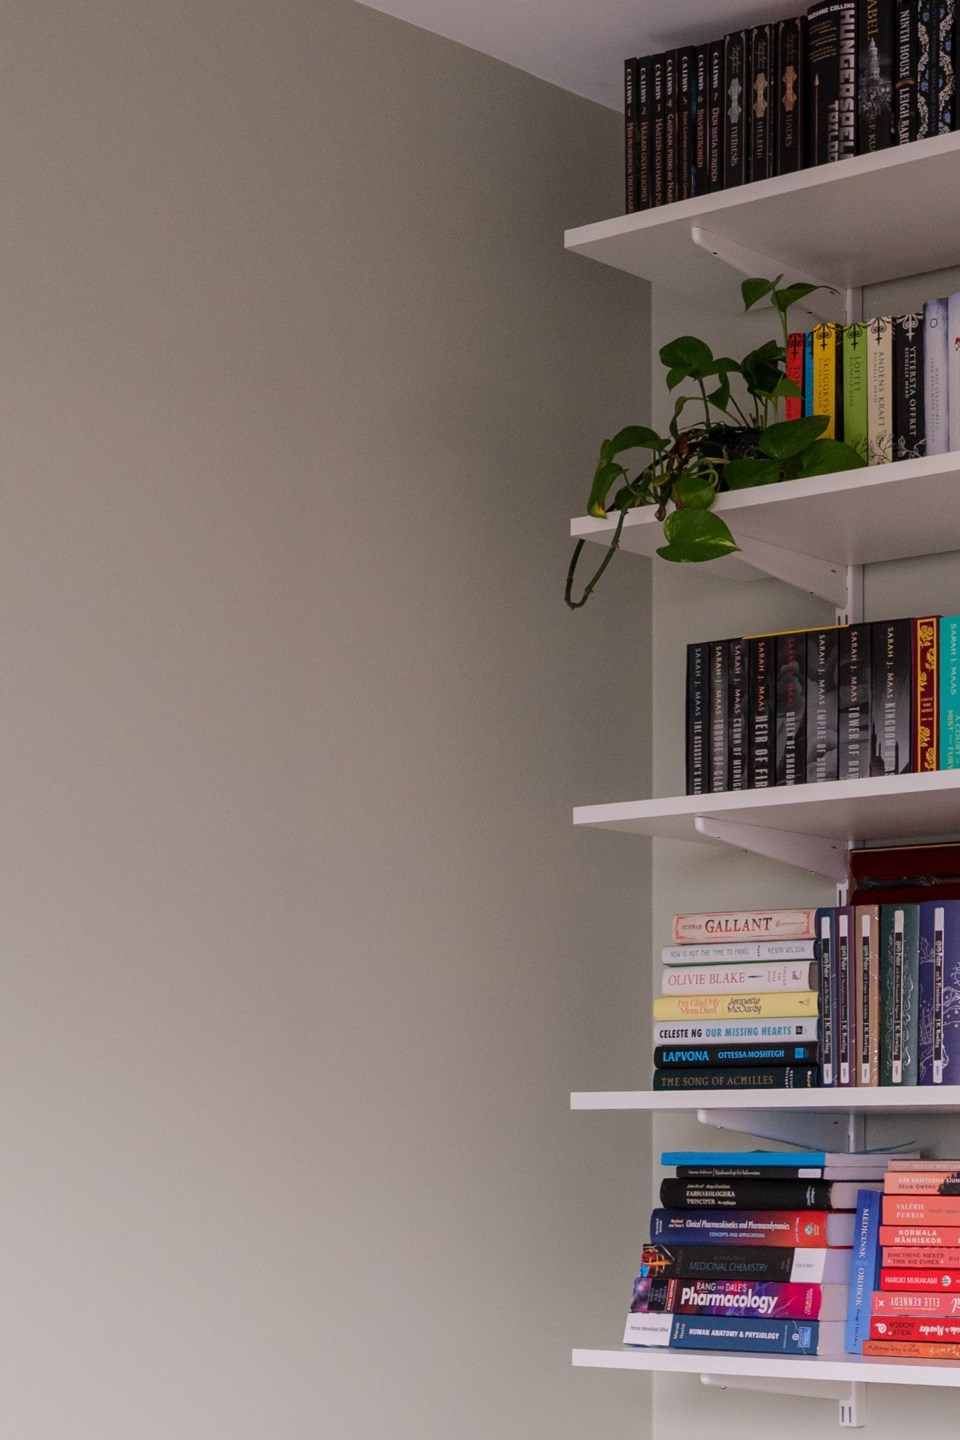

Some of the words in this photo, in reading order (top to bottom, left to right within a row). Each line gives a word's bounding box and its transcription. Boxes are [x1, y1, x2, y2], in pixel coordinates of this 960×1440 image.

[900, 9, 910, 40] NINTH
[900, 40, 910, 78] HOUSE
[900, 88, 910, 118] LEIGH
[909, 345, 918, 397] YTTERSTA
[878, 399, 886, 427] KRAFT
[909, 401, 918, 436] OFFRET
[755, 715, 768, 743] HEIR
[755, 749, 768, 762] OF
[705, 917, 772, 934] GALLANT
[668, 973, 706, 986] OLIVIE
[709, 972, 746, 984] BLAKE
[659, 1029, 688, 1039] CELESTE
[692, 1028, 702, 1038] NG
[705, 1028, 722, 1037] OUR
[724, 1026, 759, 1037] MISSING
[761, 1025, 792, 1036] HEARTS
[663, 1051, 709, 1062] LAPVONA
[718, 1051, 747, 1059] OTTESSA
[747, 1050, 785, 1059] MOSHFEGH
[661, 1077, 679, 1086] THE
[682, 1076, 709, 1086] SONG
[711, 1076, 725, 1085] OF
[727, 1075, 774, 1085] ACHILLES
[860, 1208, 869, 1258] MEDICINSK
[894, 1236, 942, 1244] MÄNNISKOR
[696, 1282, 717, 1292] RANG
[725, 1283, 747, 1293] DALE'S
[681, 1288, 778, 1314] Pharmacology
[688, 1328, 709, 1337] HUMAN
[710, 1329, 738, 1338] ANATOMY
[745, 1331, 780, 1340] PHYSIOLOGY
